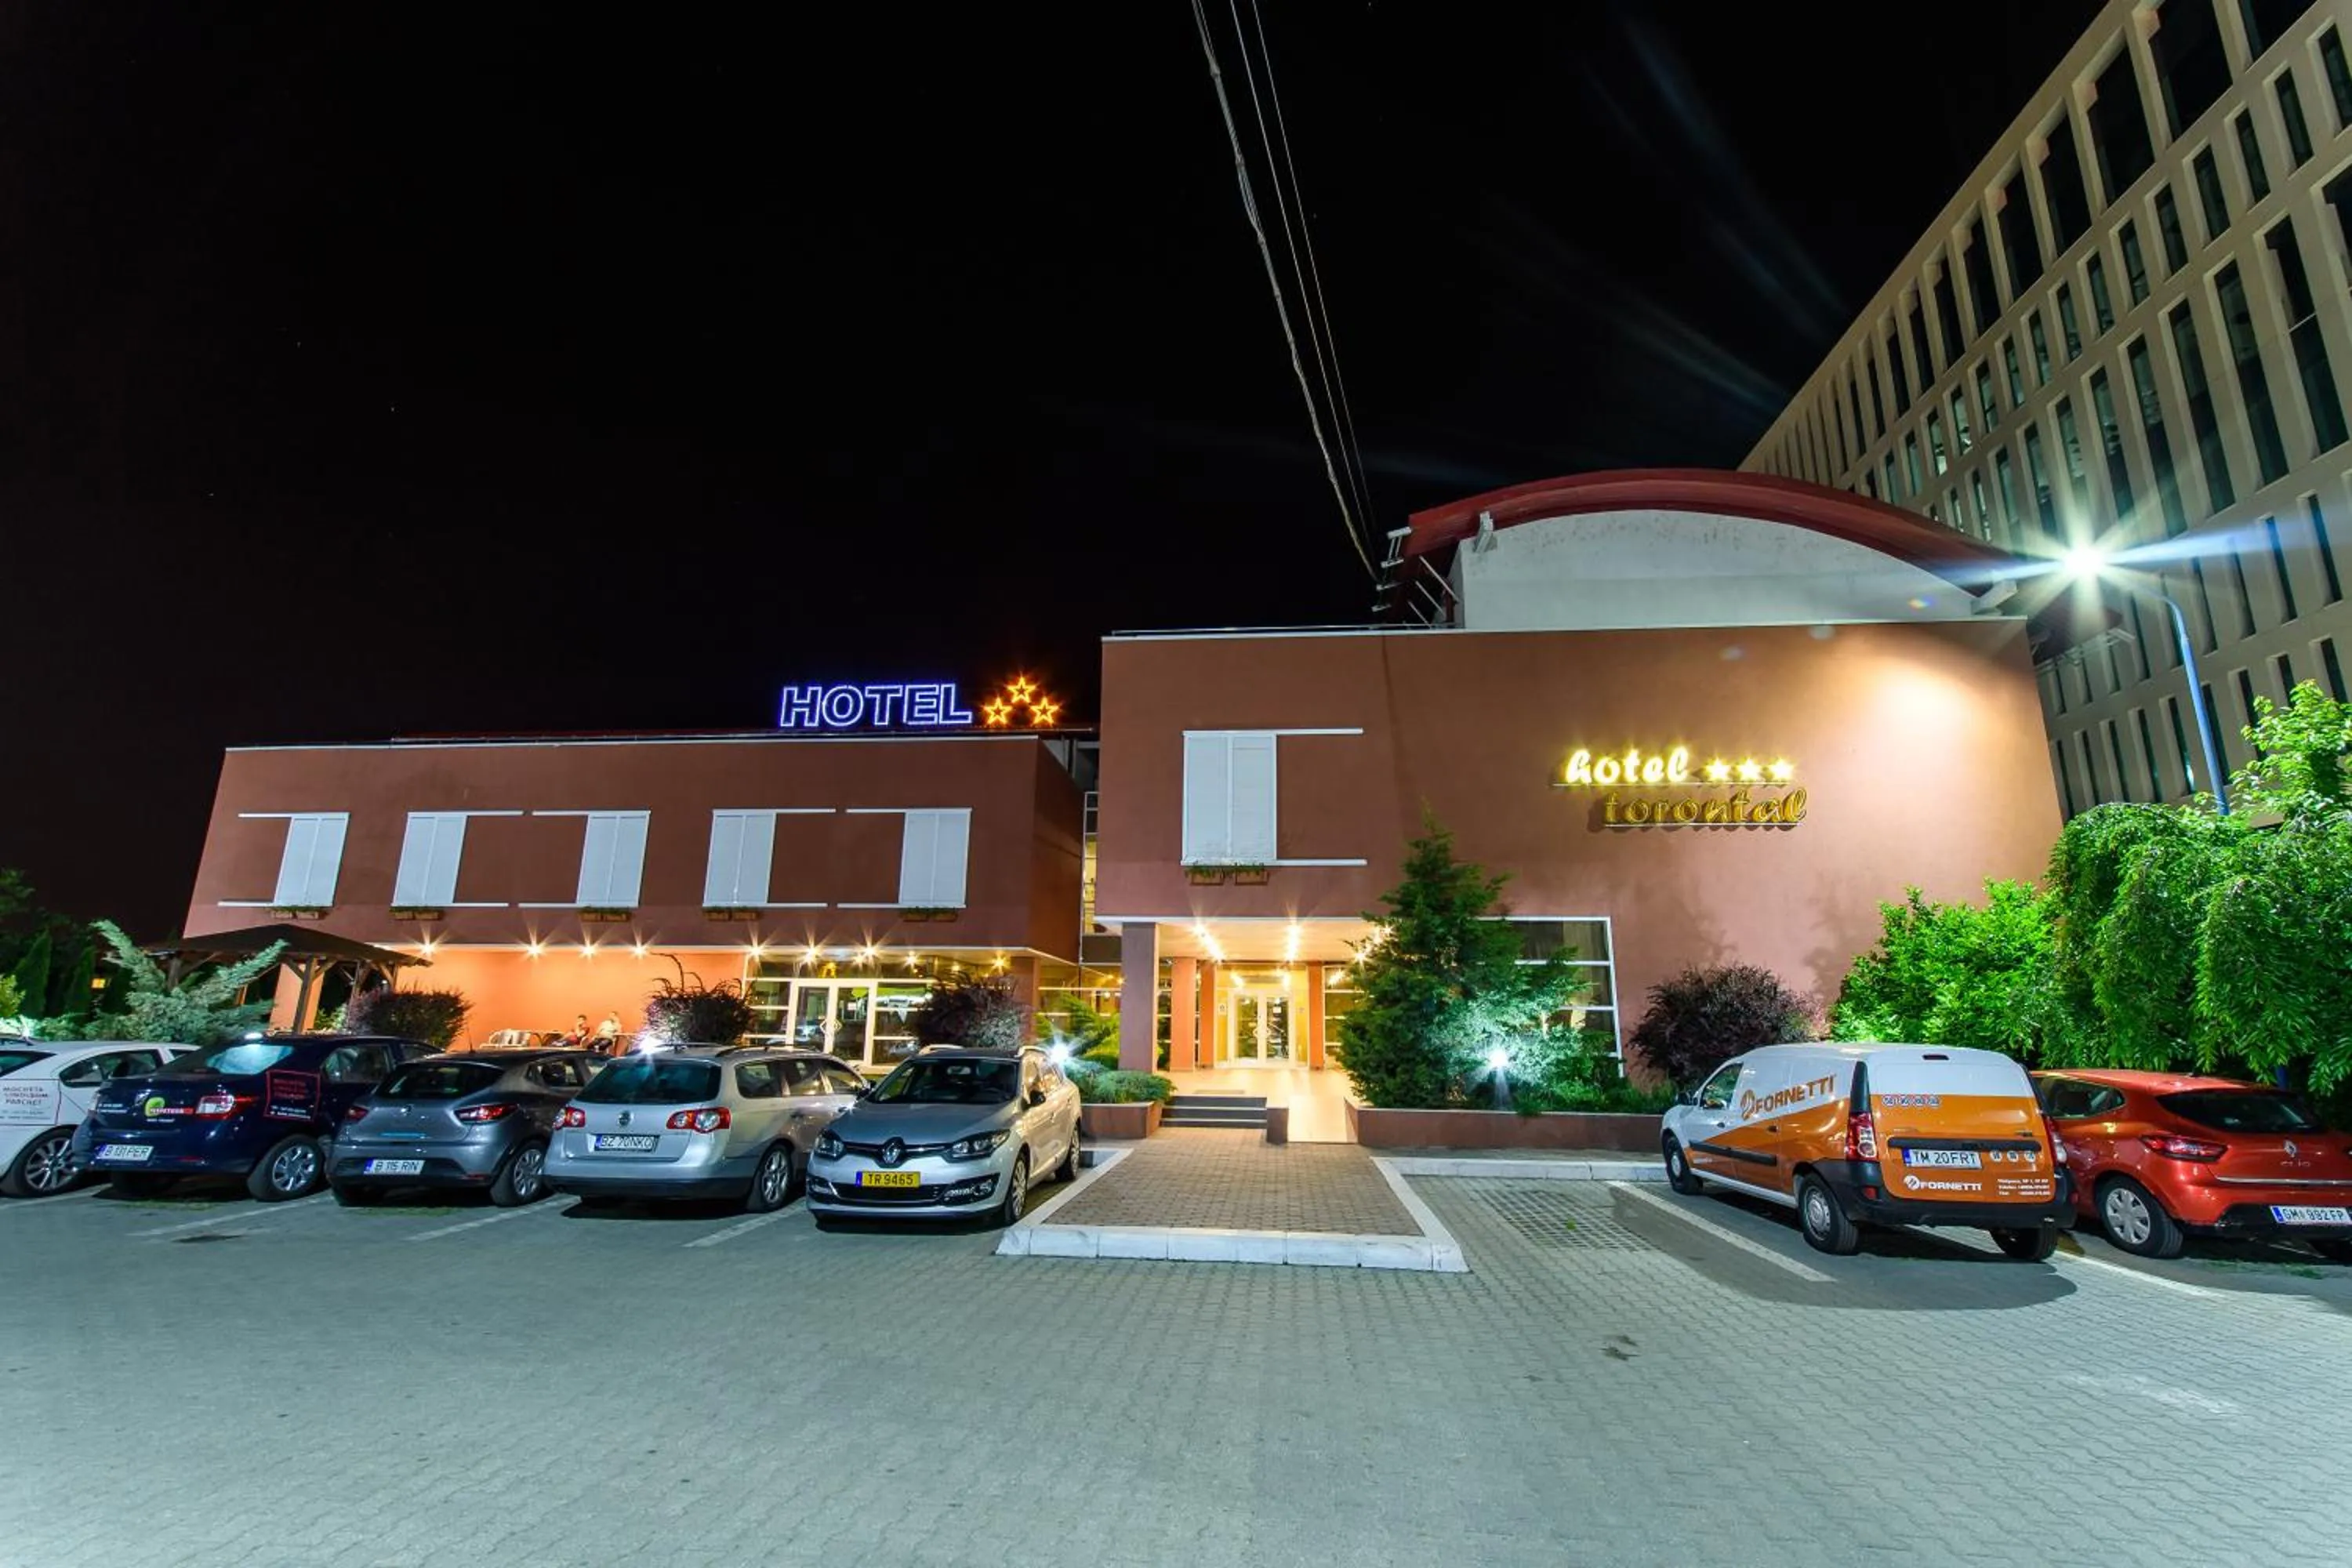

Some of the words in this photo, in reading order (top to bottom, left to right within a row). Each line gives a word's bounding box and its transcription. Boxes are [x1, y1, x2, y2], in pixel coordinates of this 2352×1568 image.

[779, 682, 972, 728] HOTEL
[1565, 746, 1690, 785] hotel
[1755, 1075, 1835, 1114] FORNETTI
[1913, 1150, 1930, 1163] TM
[868, 1174, 882, 1185] TR
[1920, 1181, 1983, 1191] FORNETTI
